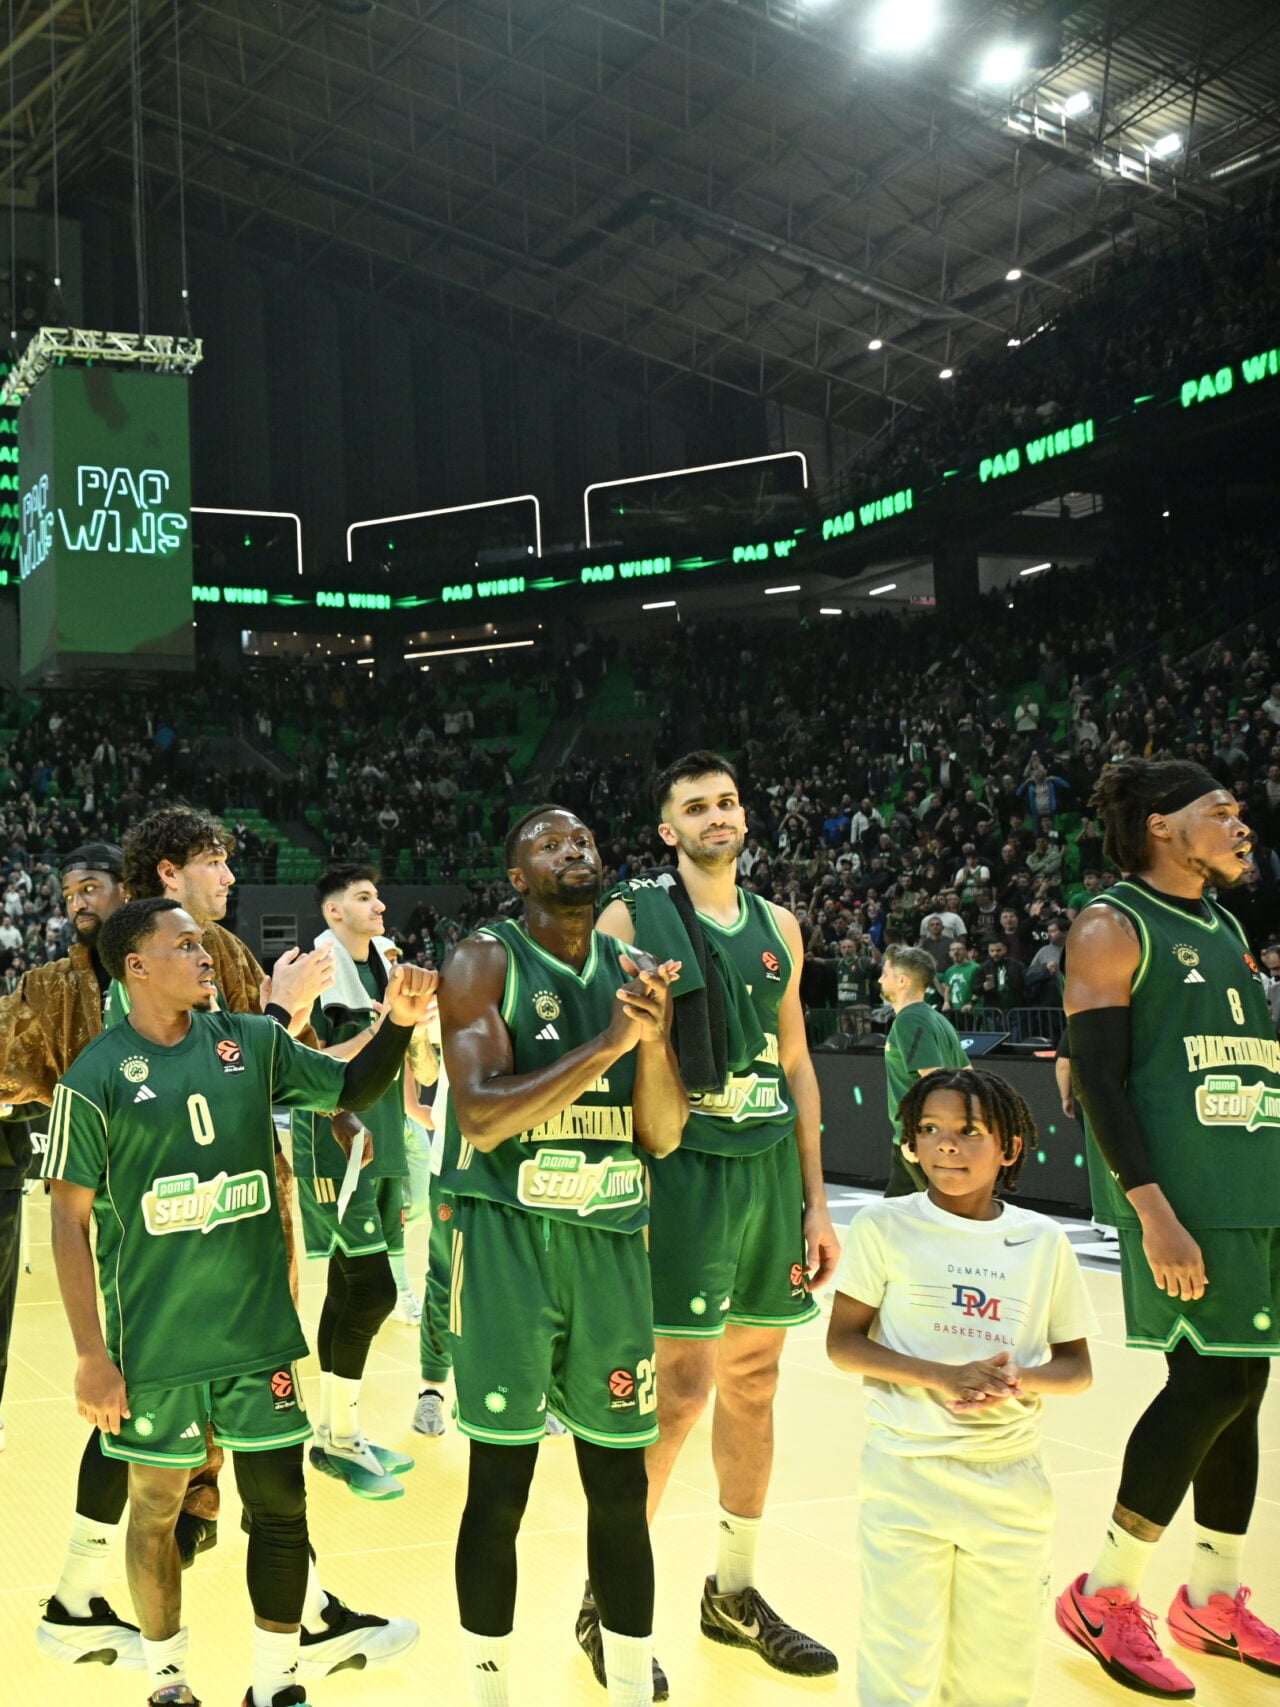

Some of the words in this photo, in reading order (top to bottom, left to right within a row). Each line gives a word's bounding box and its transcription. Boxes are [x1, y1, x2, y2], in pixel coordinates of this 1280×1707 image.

[1242, 348, 1280, 384] WI
[979, 448, 1020, 482] PAO
[57, 508, 188, 554] WINS
[822, 510, 855, 541] PAO
[1227, 987, 1245, 1025] 8
[186, 1093, 216, 1146] 0
[542, 1155, 578, 1169] pame
[159, 1179, 191, 1195] pame
[934, 1322, 1017, 1346] BASKETBALL
[497, 1385, 508, 1393] bp
[146, 1411, 155, 1419] bp
